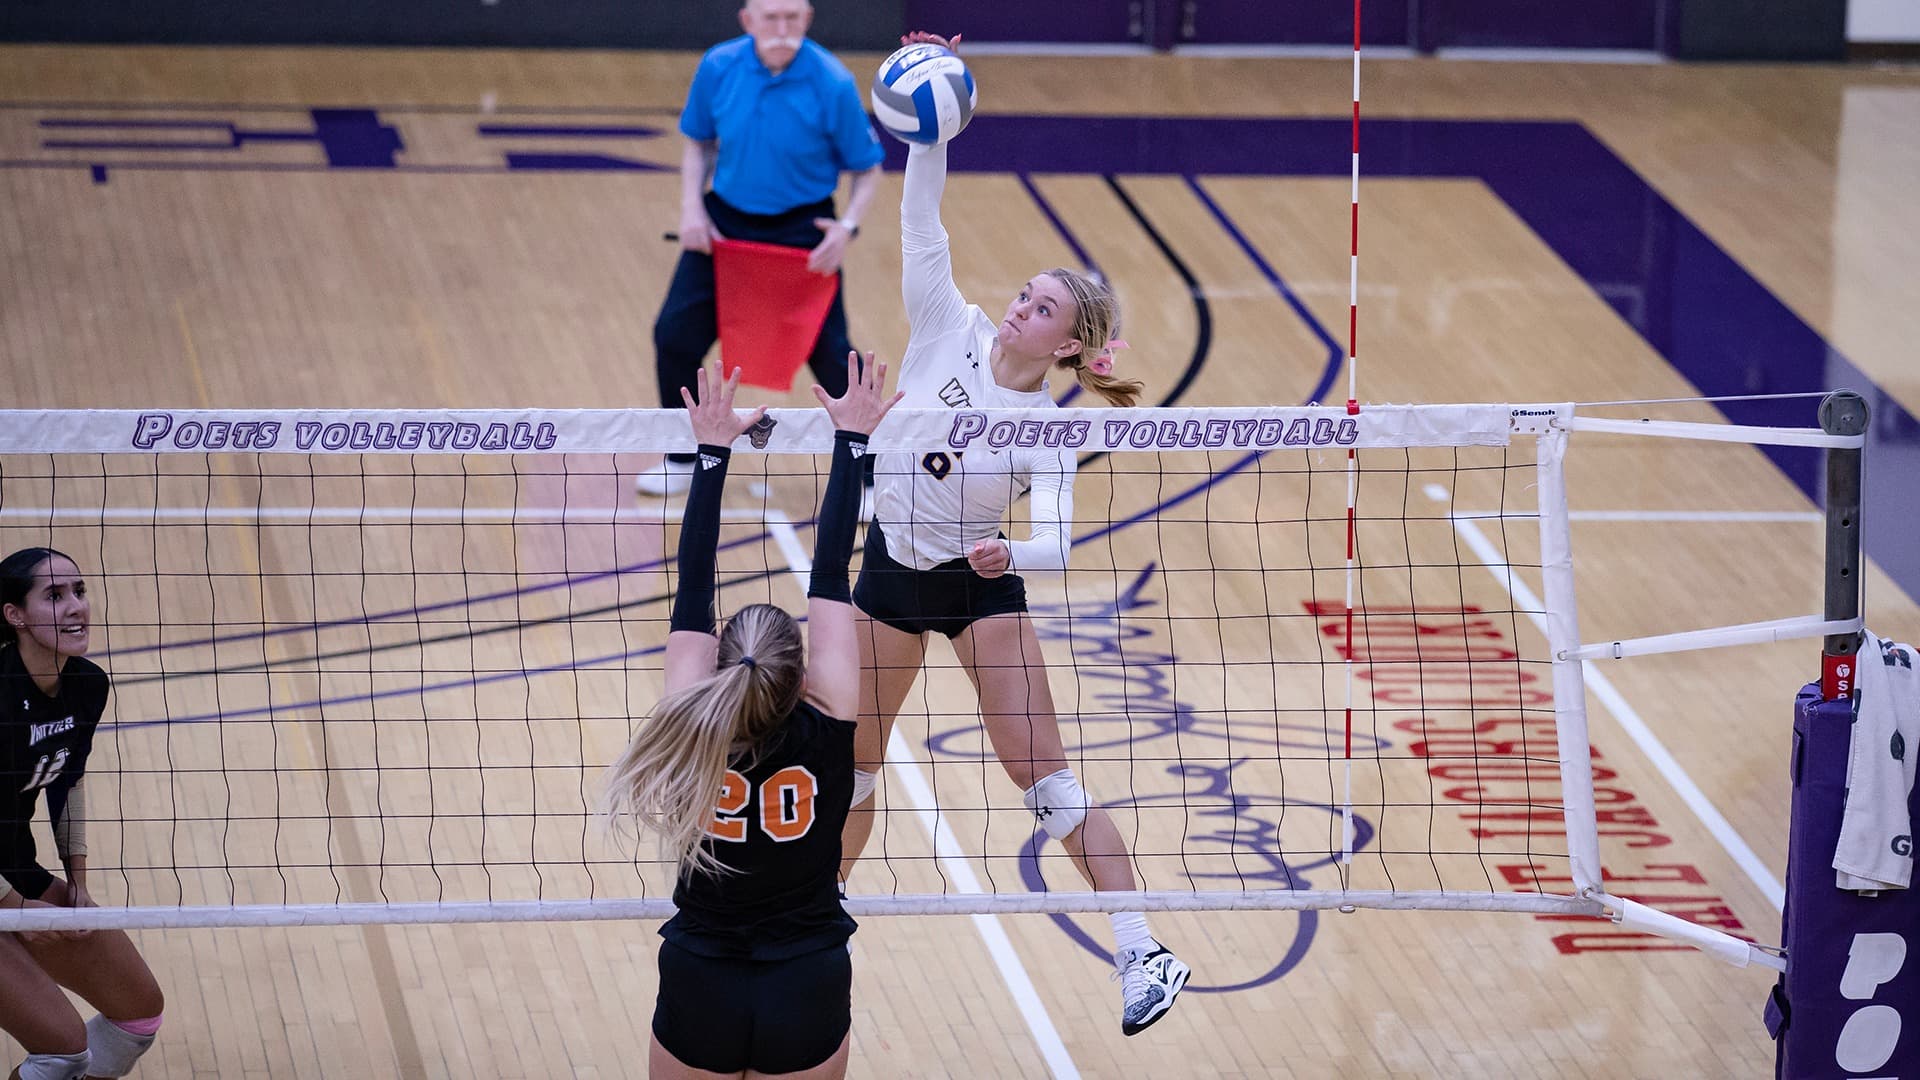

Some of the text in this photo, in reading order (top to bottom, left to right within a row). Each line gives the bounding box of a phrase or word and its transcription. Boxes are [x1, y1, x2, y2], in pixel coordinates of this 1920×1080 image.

[132, 413, 557, 451] POETS VOLLEYBALL
[948, 412, 1360, 449] POETS VOLLEYBALL
[1519, 409, 1556, 417] Senoh
[1301, 601, 1555, 705] COURT
[703, 764, 819, 844] 20
